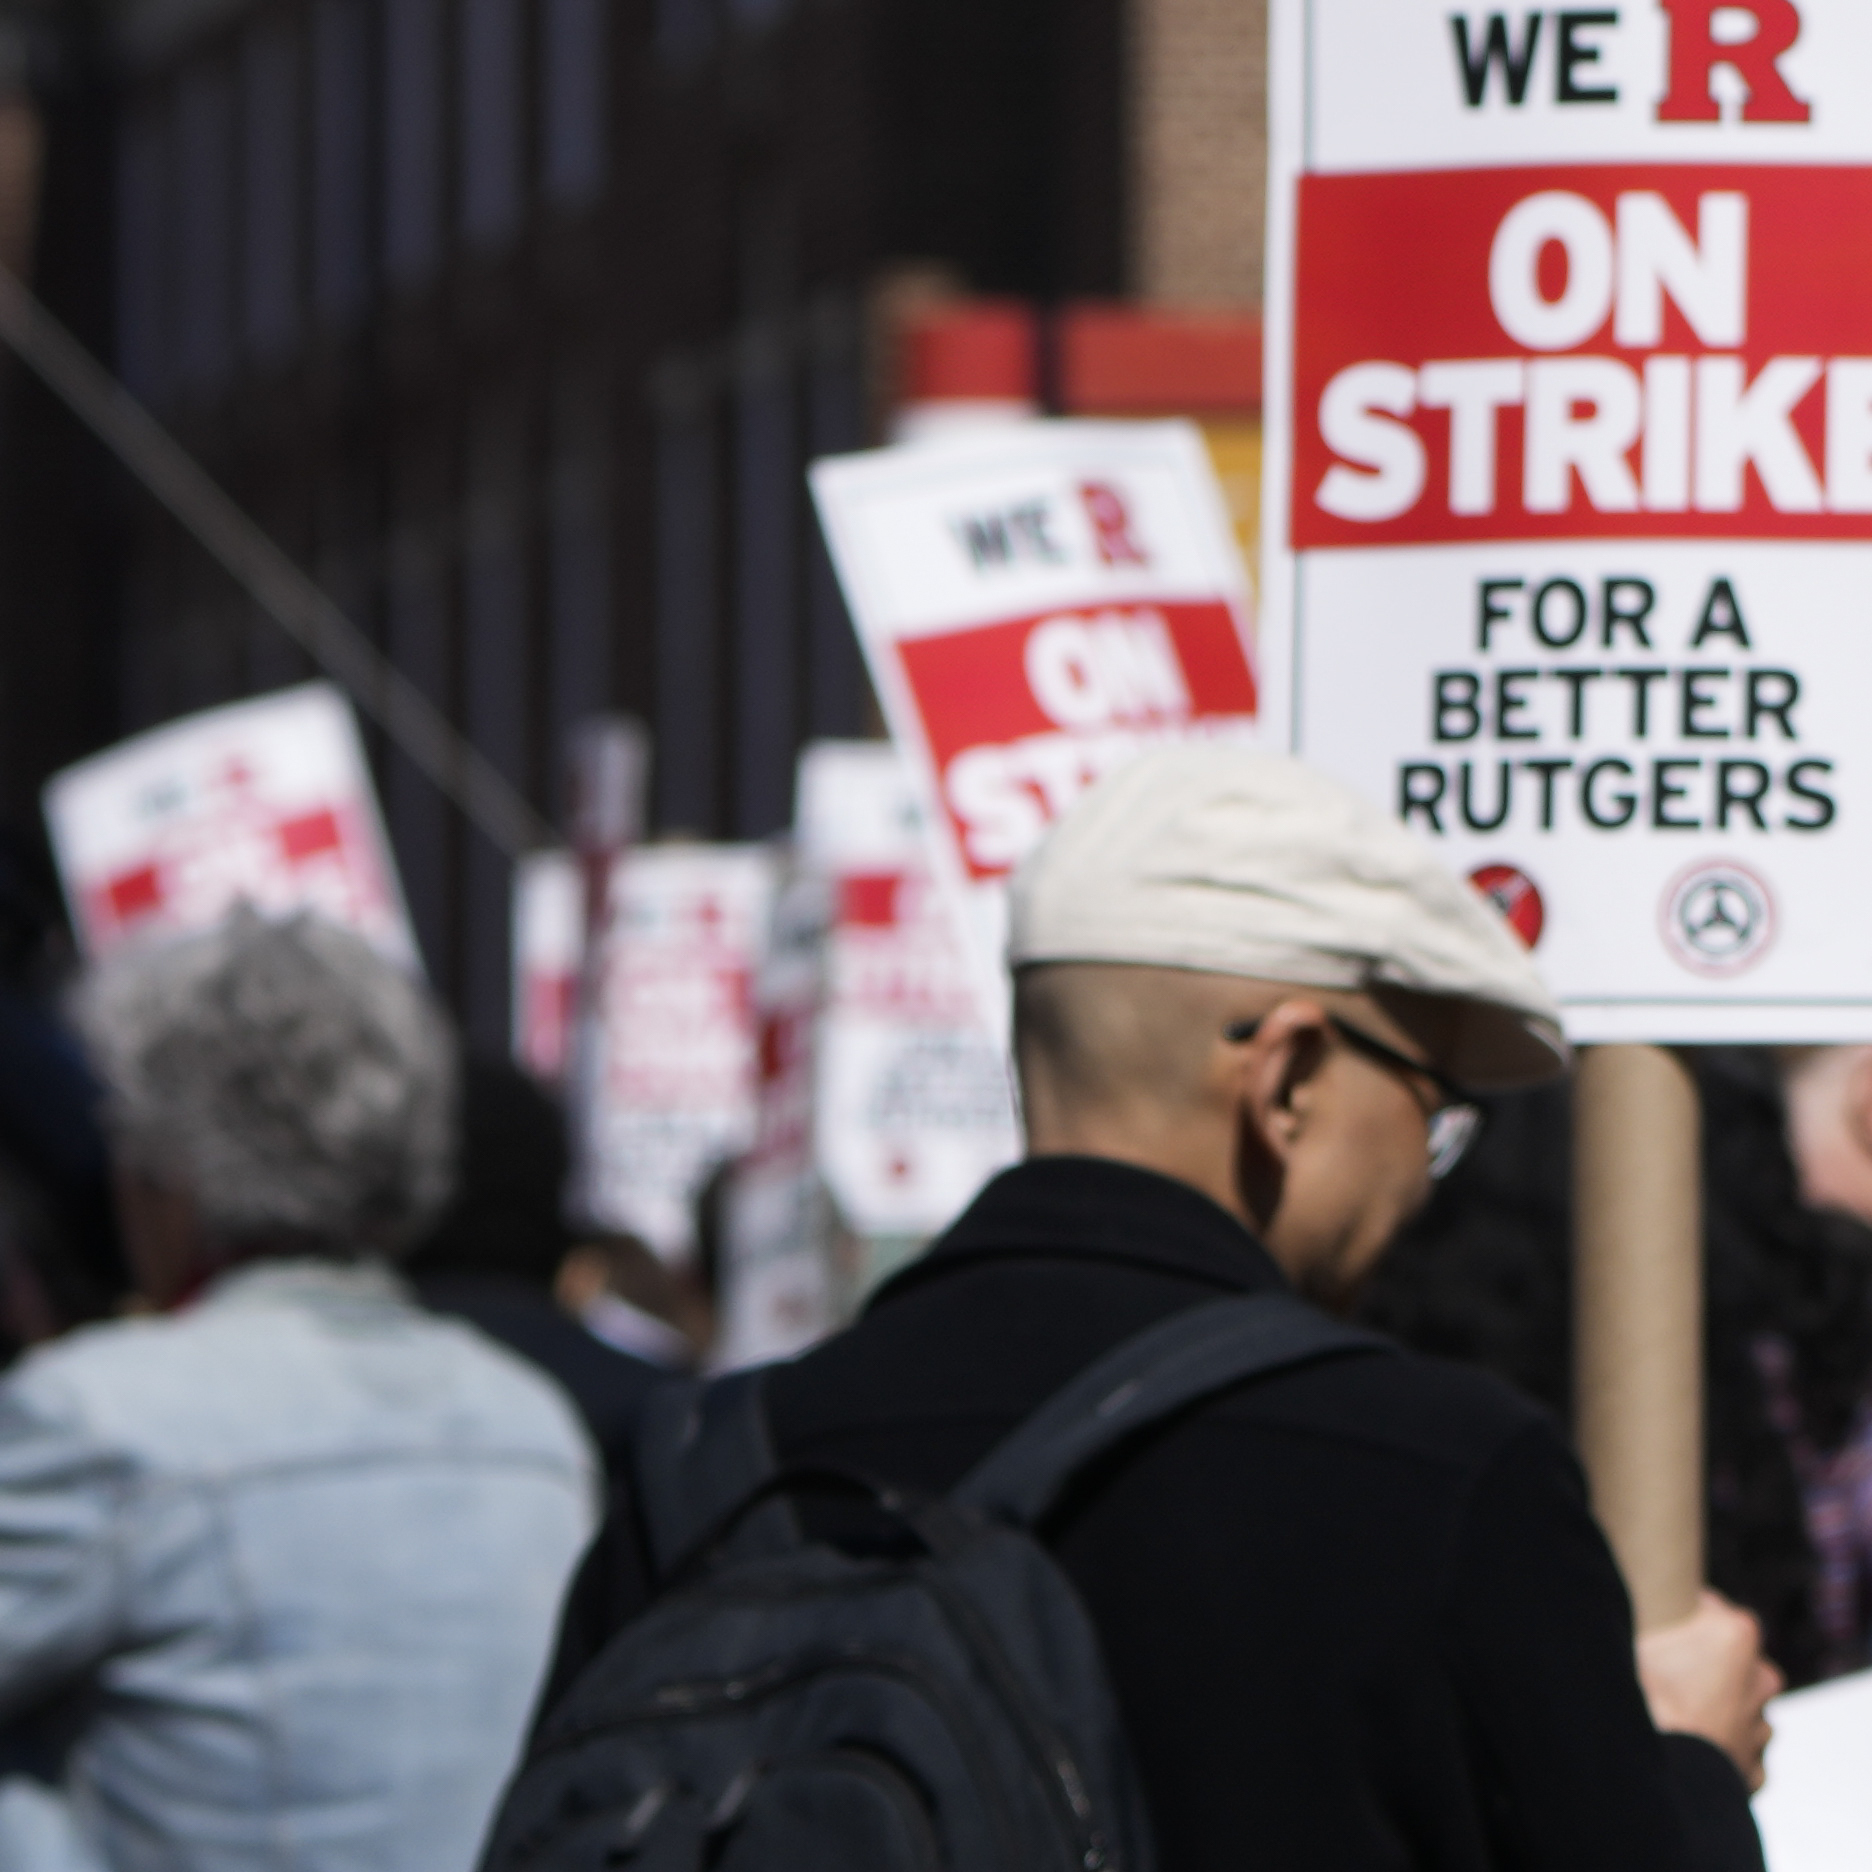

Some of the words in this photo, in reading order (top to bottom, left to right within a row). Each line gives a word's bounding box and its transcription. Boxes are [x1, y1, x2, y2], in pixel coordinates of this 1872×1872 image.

[1449, 7, 1621, 109] WE
[1486, 189, 1749, 351] ON
[1476, 576, 1657, 654] FOR
[1690, 579, 1753, 651] A
[1431, 665, 1803, 745] BETTER
[1398, 755, 1839, 836] RUTGERS
